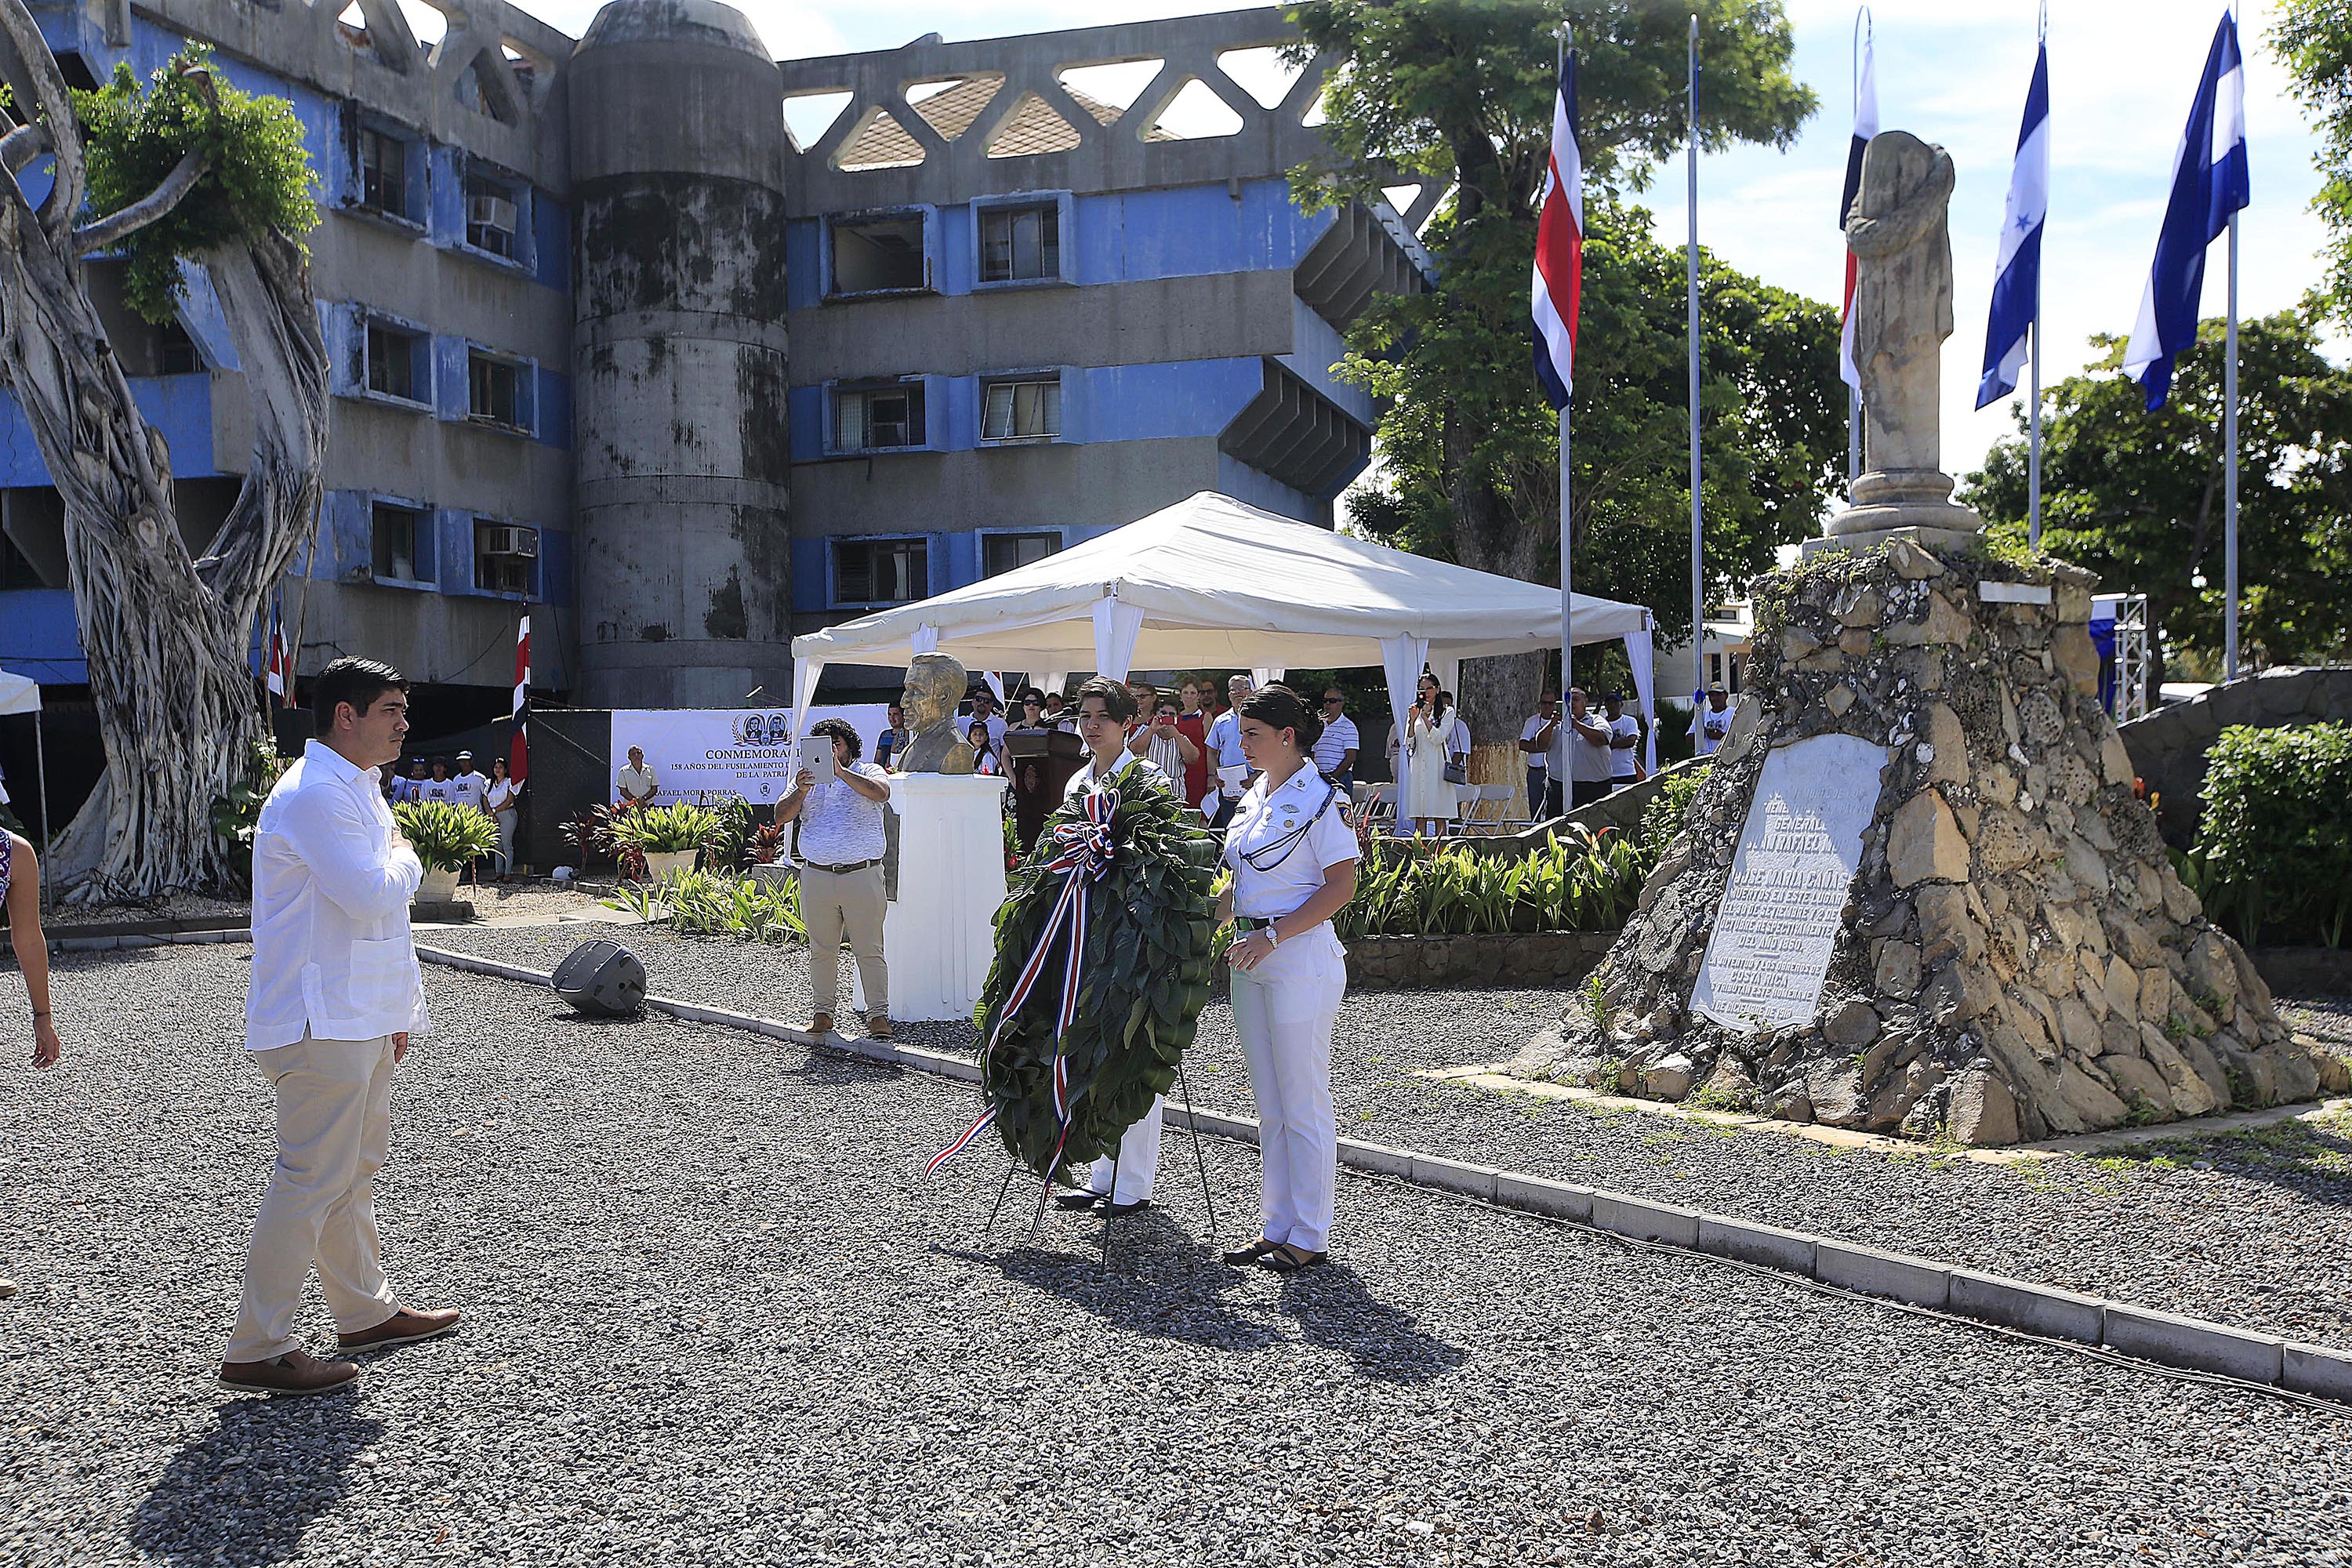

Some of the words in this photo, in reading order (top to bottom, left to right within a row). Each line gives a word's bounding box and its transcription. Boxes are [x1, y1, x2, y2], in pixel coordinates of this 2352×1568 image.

[684, 761, 707, 770] AÑOS
[725, 761, 783, 770] FUSILAMIENTO
[1776, 833, 1819, 852] RAFAEL
[1766, 869, 1803, 887] MARIA
[1806, 868, 1849, 890] CAÑAS
[1730, 887, 1770, 901] MUERTOS
[1771, 888, 1785, 901] EN
[1785, 889, 1810, 903] ESTE
[1810, 891, 1843, 906] LUGAR
[1723, 902, 1734, 914] EL
[1747, 903, 1761, 916] DE
[1761, 904, 1809, 920] SETIEMBRE
[1824, 908, 1839, 921] DE
[1719, 917, 1756, 932] OCTUBRE
[1756, 919, 1834, 938] RESPECTIVAMENTE
[1738, 934, 1757, 947] DEL
[1759, 935, 1779, 949] AÑO
[1708, 954, 1718, 966] LA
[1755, 958, 1762, 971] Y
[1762, 960, 1777, 971] LOS
[1777, 962, 1809, 974] OBREROS
[1809, 964, 1823, 976] DE
[1731, 969, 1762, 985] COSTA
[1762, 971, 1788, 988] RICA
[1715, 981, 1751, 996] TRIBUTAN
[1751, 985, 1773, 996] ESTE
[1773, 987, 1813, 1001] HOMENAJE
[1715, 1000, 1727, 1011] DE
[1726, 1001, 1764, 1015] DICIEMBRE
[1764, 1006, 1777, 1018] DE
